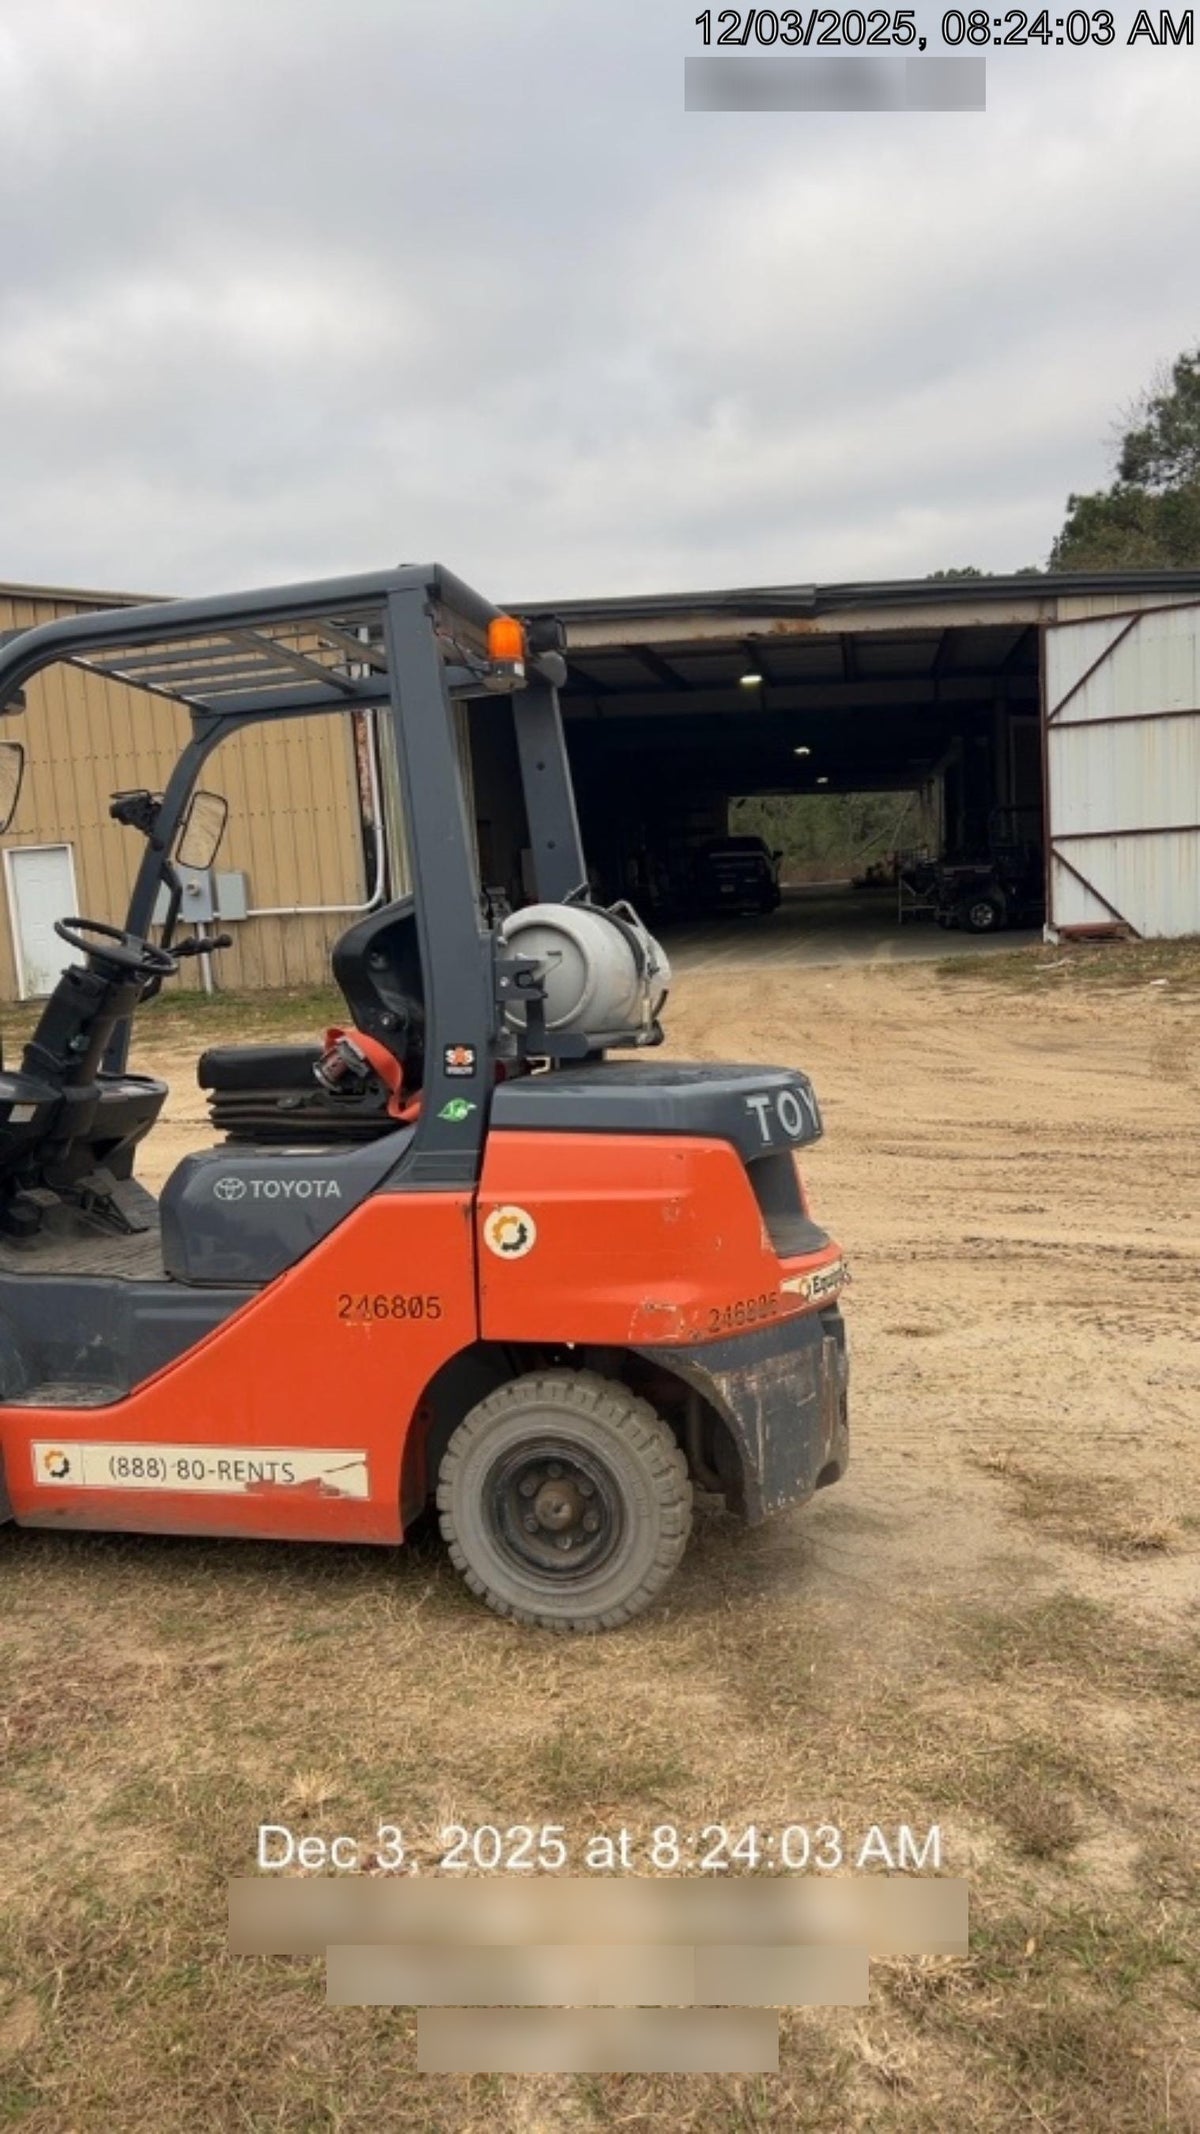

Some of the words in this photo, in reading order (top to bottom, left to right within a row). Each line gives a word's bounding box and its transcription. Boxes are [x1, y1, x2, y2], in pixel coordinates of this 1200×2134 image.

[249, 1179, 341, 1198] TOYOTA
[338, 1294, 442, 1320] 246805
[109, 1455, 167, 1482] (888)
[177, 1459, 294, 1483] 80-RENTS
